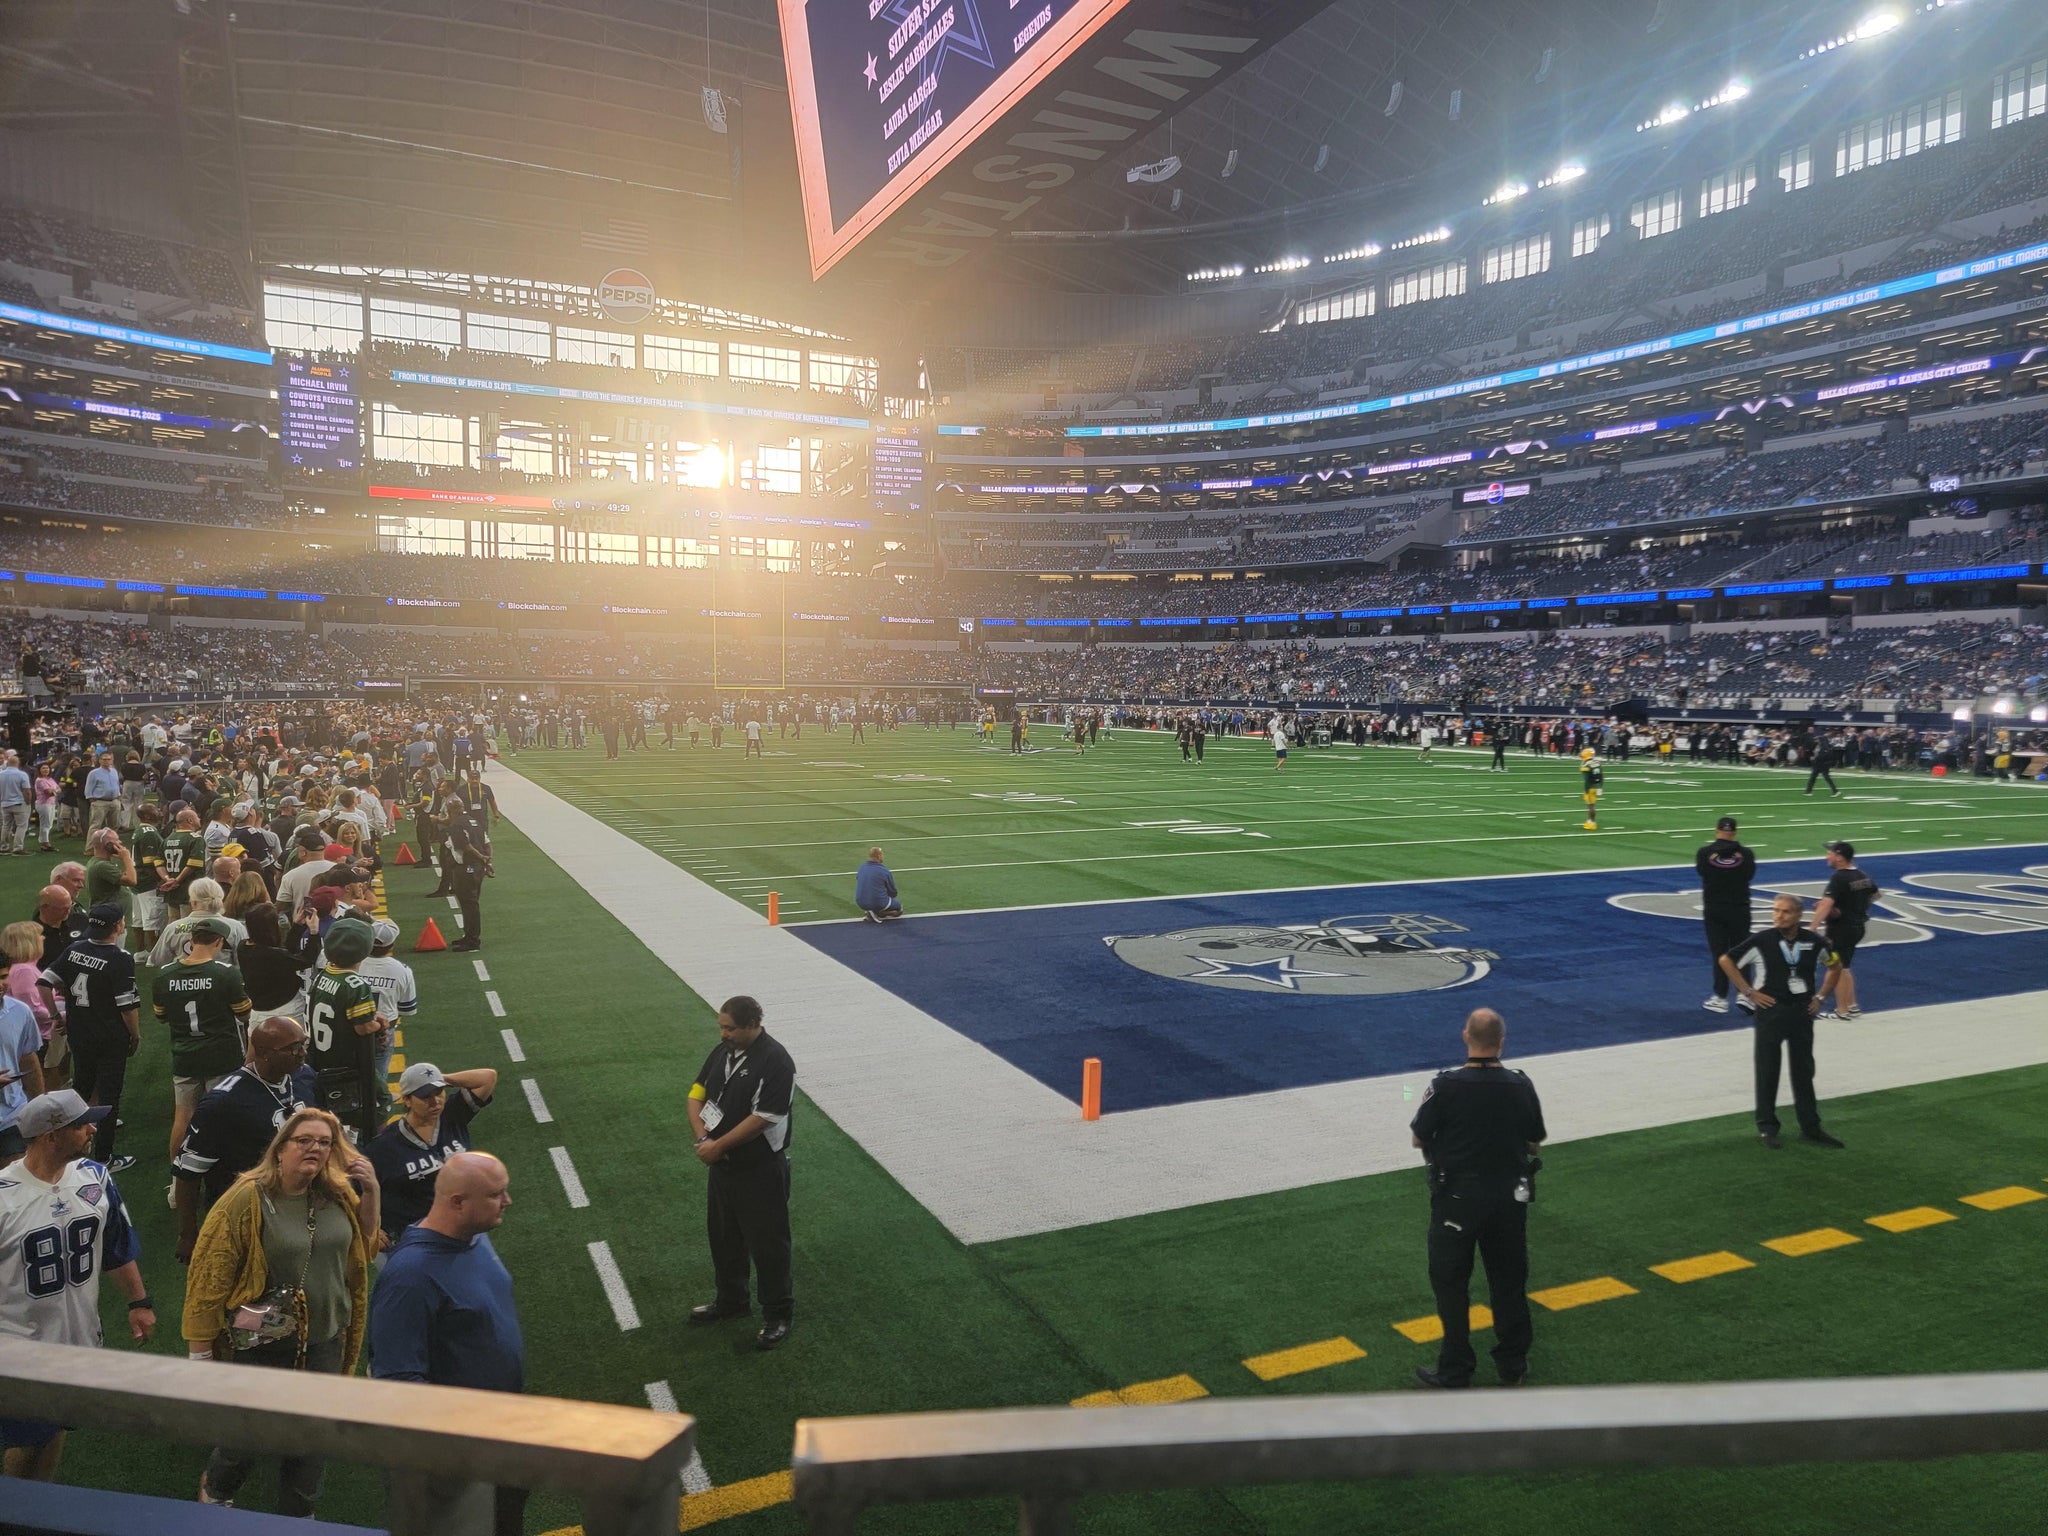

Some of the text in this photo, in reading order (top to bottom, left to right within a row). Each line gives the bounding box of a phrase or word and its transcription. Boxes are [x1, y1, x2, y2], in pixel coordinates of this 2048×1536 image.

[888, 5, 922, 60] SILVER
[1013, 4, 1052, 54] LEGENDS
[879, 5, 955, 104] LESLIE CARRIZALES
[883, 71, 938, 140] LAURA GARCIA
[887, 109, 943, 175] ELVIA MELGAR
[1970, 261, 1995, 275] FROM
[1997, 256, 2014, 269] THE
[602, 287, 652, 305] PEPSI
[1743, 319, 1762, 330] FROM
[1765, 315, 1778, 325] THE
[1811, 304, 1820, 314] OF
[290, 377, 348, 392] MICHAEL IRVIN
[399, 372, 417, 381] FROM
[418, 374, 430, 382] THE
[431, 376, 457, 385] MAKERS
[467, 379, 493, 389] BUFFALO
[493, 382, 512, 391] SLOTS
[1817, 385, 1848, 401] DALLAS
[1898, 369, 1935, 386] KANSAS
[289, 391, 354, 406] COWBOYS RECEIVER
[876, 437, 919, 447] MICHAEL IRVIN
[875, 449, 899, 457] COWBOYS
[1930, 479, 1957, 493] 49:29
[607, 503, 630, 512] 49:29
[800, 518, 822, 526] American
[834, 520, 856, 528] American
[397, 598, 460, 608] Blockchain.com
[507, 602, 567, 612] Blockchain.com
[611, 605, 668, 615] Blockchain.com
[709, 609, 762, 619] Blockchain.com
[800, 612, 850, 622] Blockchain.com
[888, 615, 935, 624] Blockchain.com
[959, 621, 973, 632] 40
[164, 849, 183, 873] 87
[68, 950, 108, 971] PRESCOTT
[169, 977, 213, 992] PARSONS
[361, 975, 396, 989] SCOTT
[70, 972, 90, 1008] 4
[184, 1000, 206, 1037] 1
[20, 1213, 101, 1299] 88
